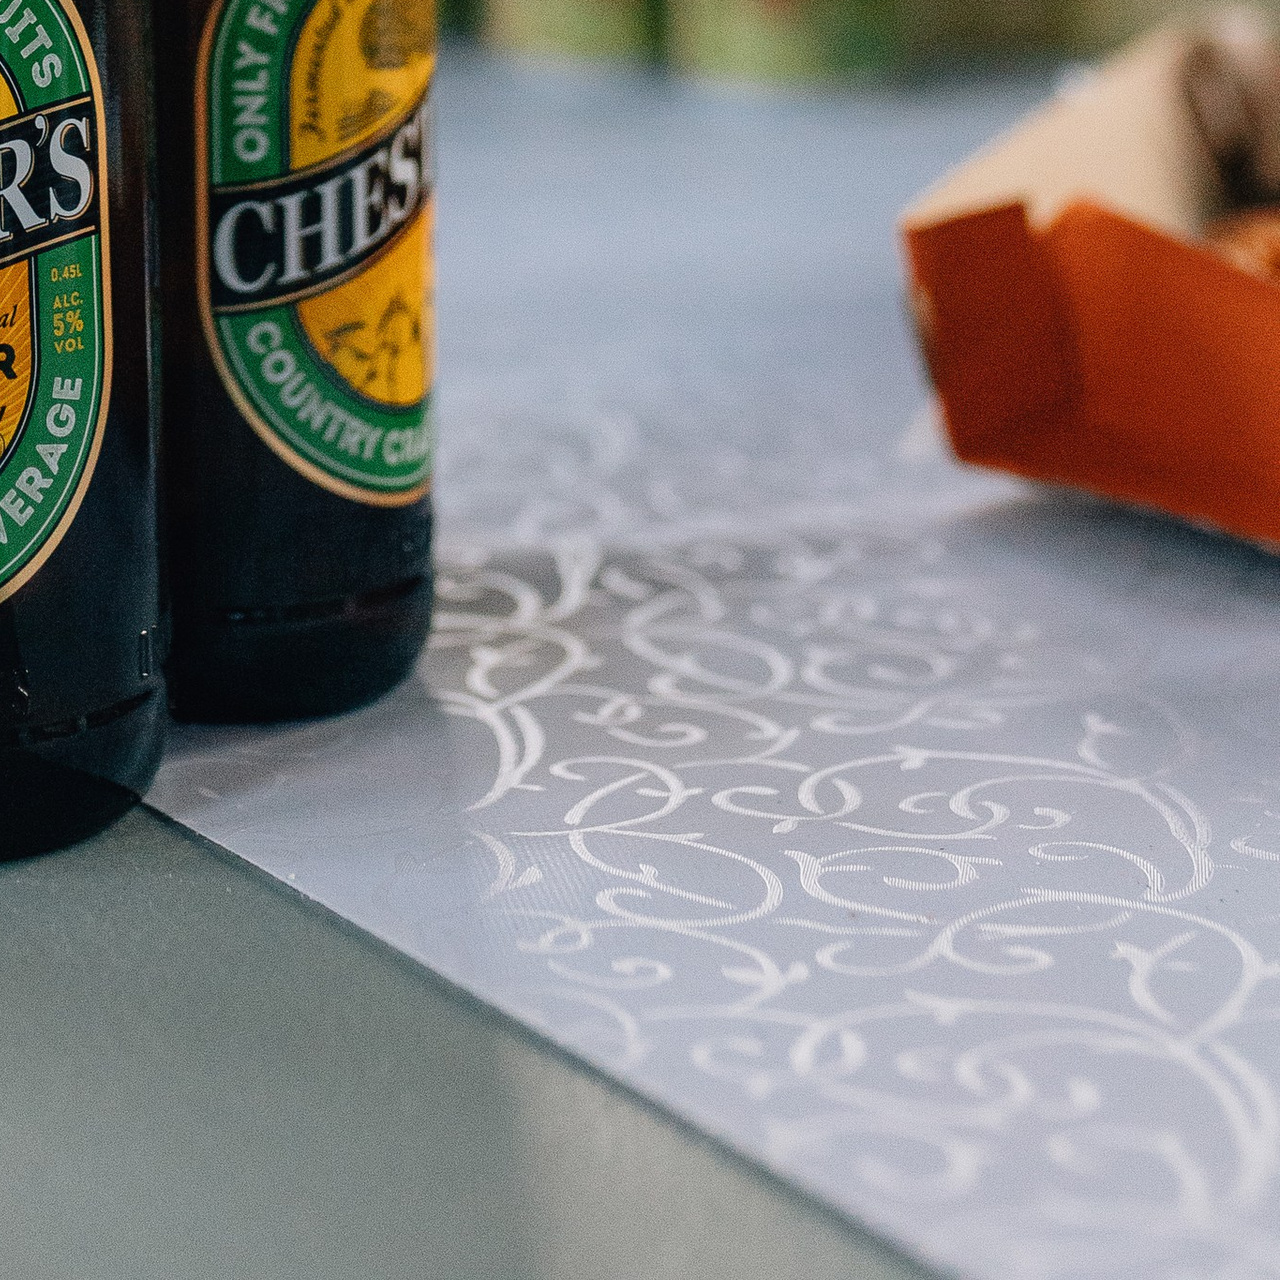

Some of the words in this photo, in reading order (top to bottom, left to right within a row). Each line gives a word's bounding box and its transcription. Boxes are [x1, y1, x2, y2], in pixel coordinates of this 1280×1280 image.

[232, 41, 270, 163] ONLY
[213, 115, 431, 294] CHES
[51, 263, 83, 283] 0.45L
[52, 290, 84, 310] ALC.
[53, 309, 85, 337] 5%
[53, 336, 86, 354] VOL
